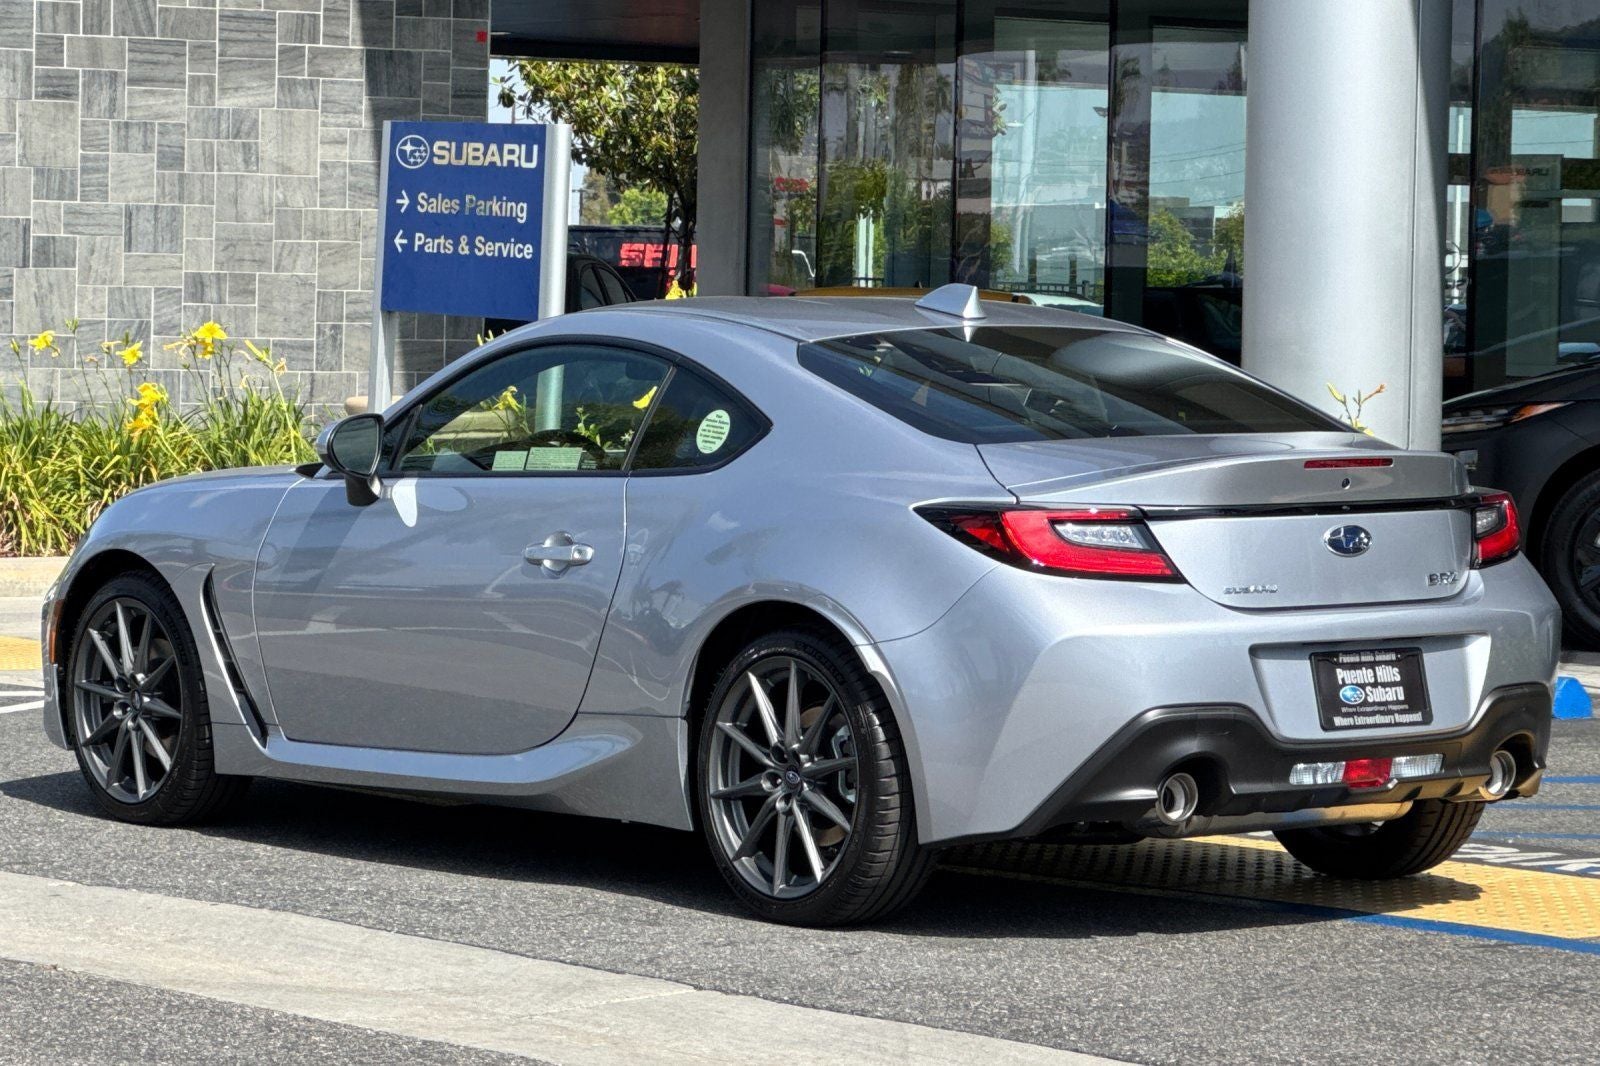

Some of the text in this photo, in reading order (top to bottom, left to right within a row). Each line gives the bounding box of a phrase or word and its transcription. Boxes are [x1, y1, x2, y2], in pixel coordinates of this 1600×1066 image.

[432, 141, 538, 169] SUBARU
[417, 192, 527, 223] Sales Parking
[413, 232, 533, 259] Parts & Service
[1426, 571, 1459, 587] BRZ
[1224, 584, 1279, 595] SUBARU
[1336, 665, 1400, 684] Puente Hills
[1366, 686, 1404, 702] Subaru
[1333, 712, 1422, 727] Where Extraordinary Happens!
